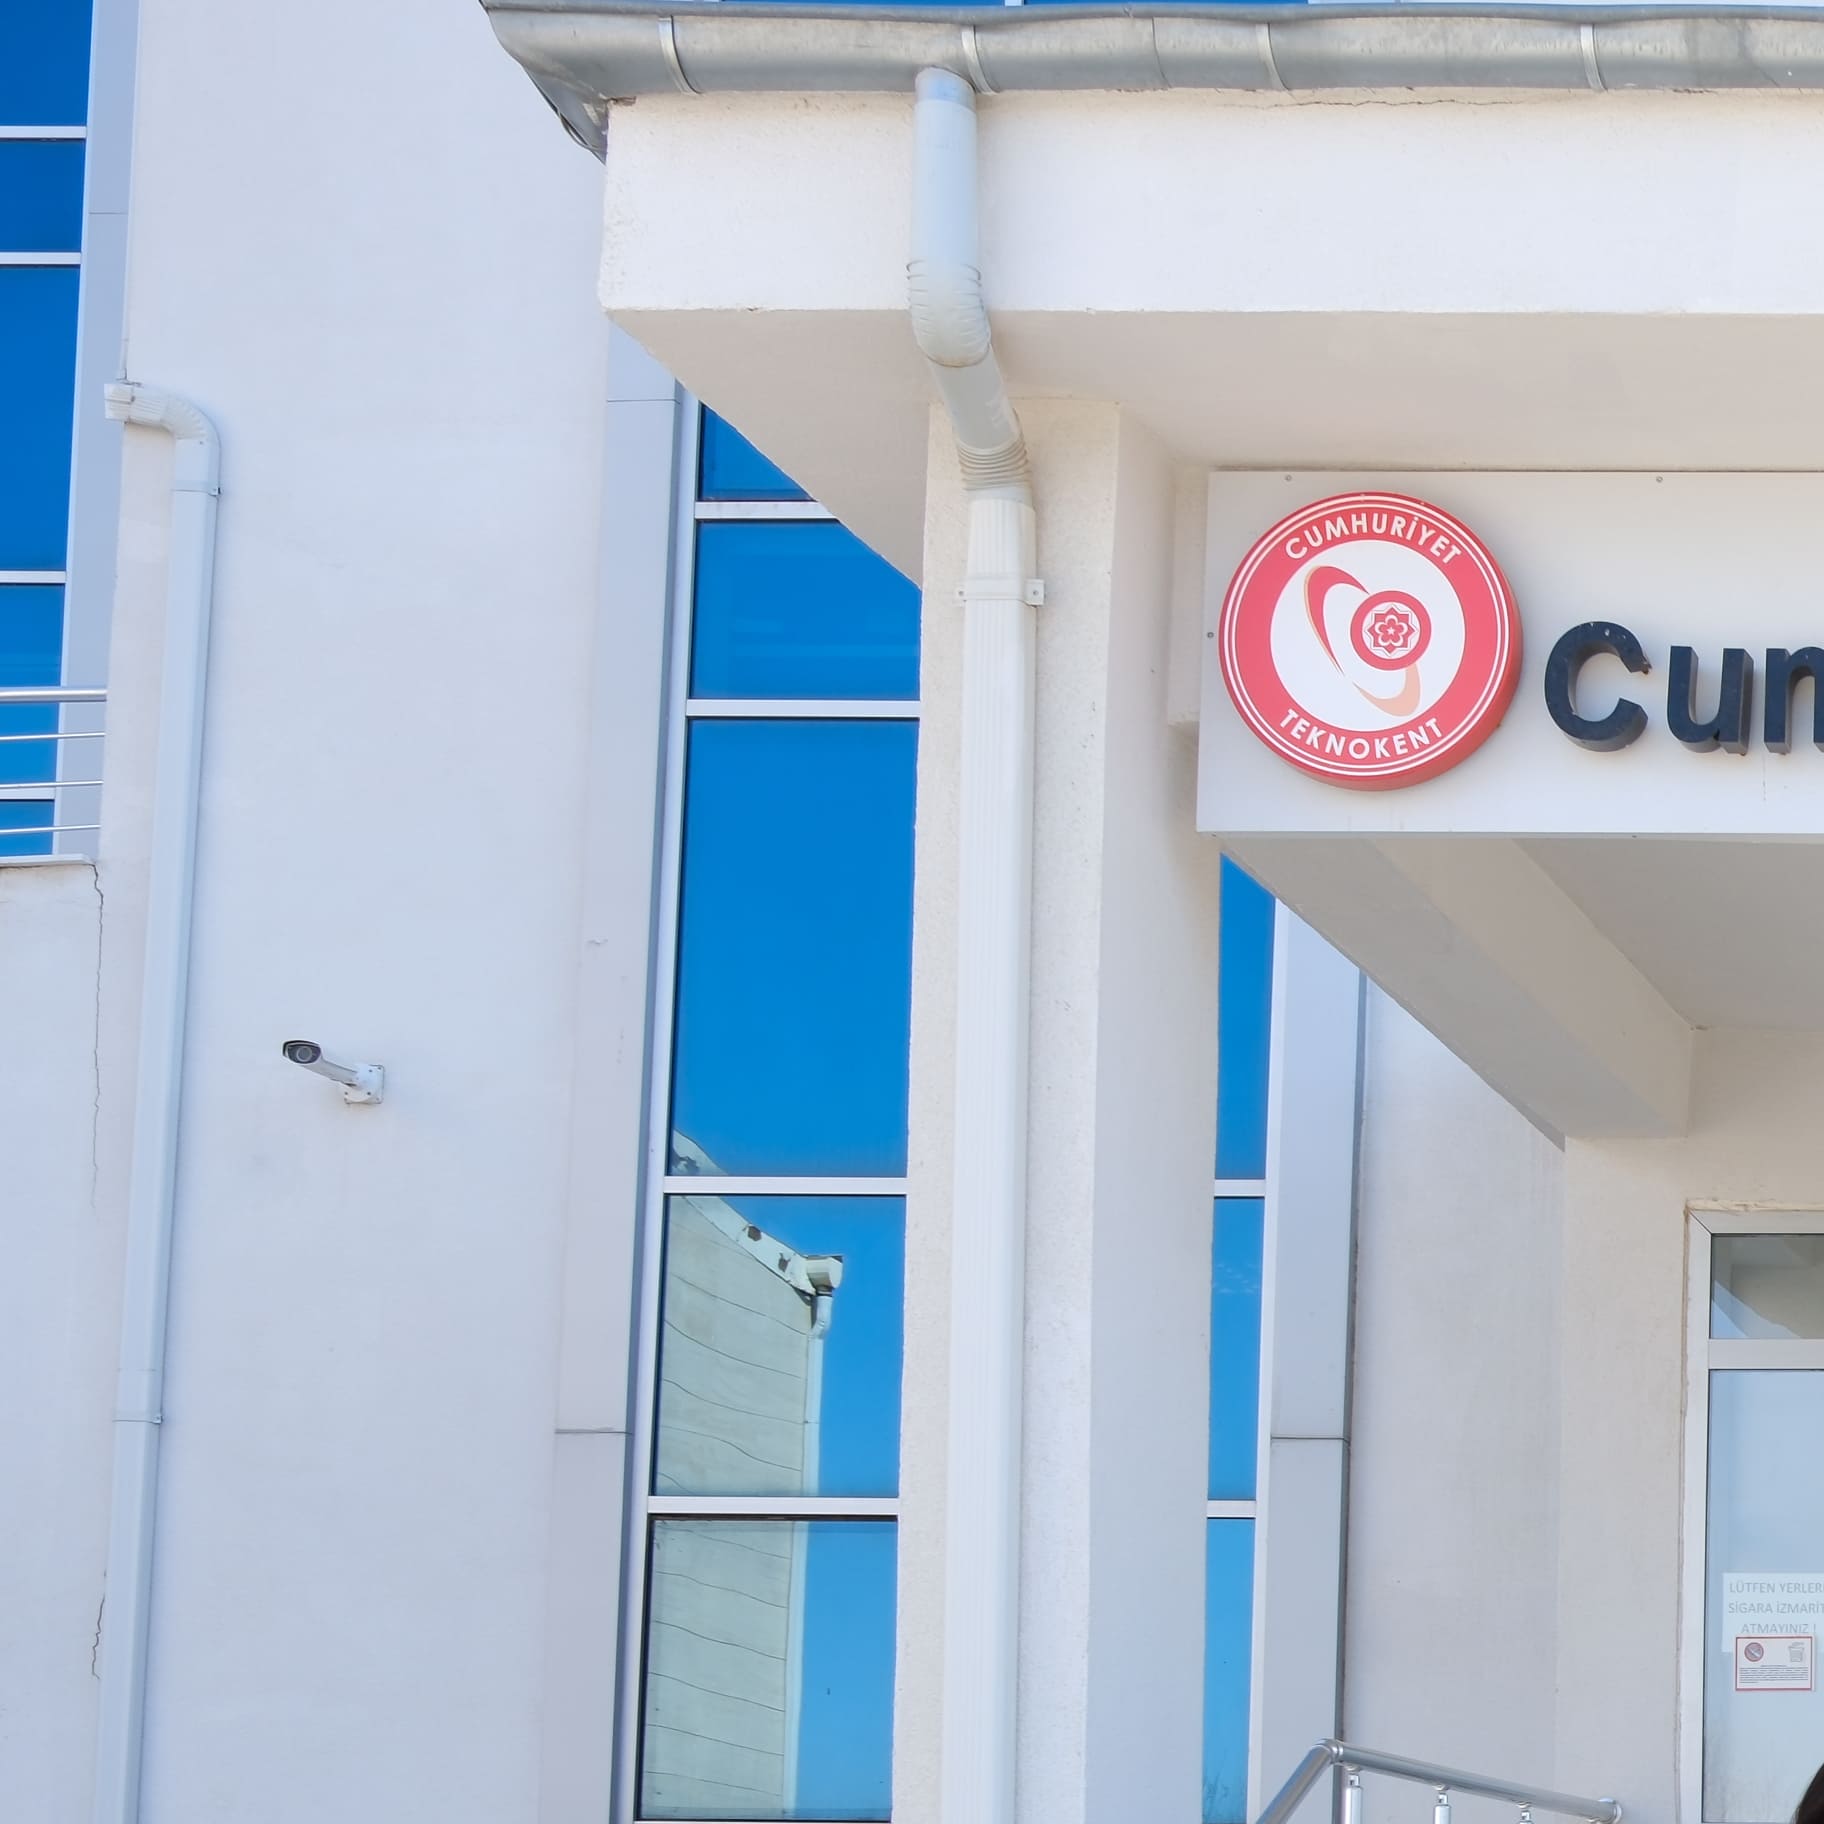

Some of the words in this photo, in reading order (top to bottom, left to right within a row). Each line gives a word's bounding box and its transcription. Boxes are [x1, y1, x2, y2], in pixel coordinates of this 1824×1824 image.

[1285, 512, 1462, 564] CUMHURİYET
[1279, 708, 1445, 760] TEKNOKENT
[1729, 1580, 1775, 1594] LÜTFEN
